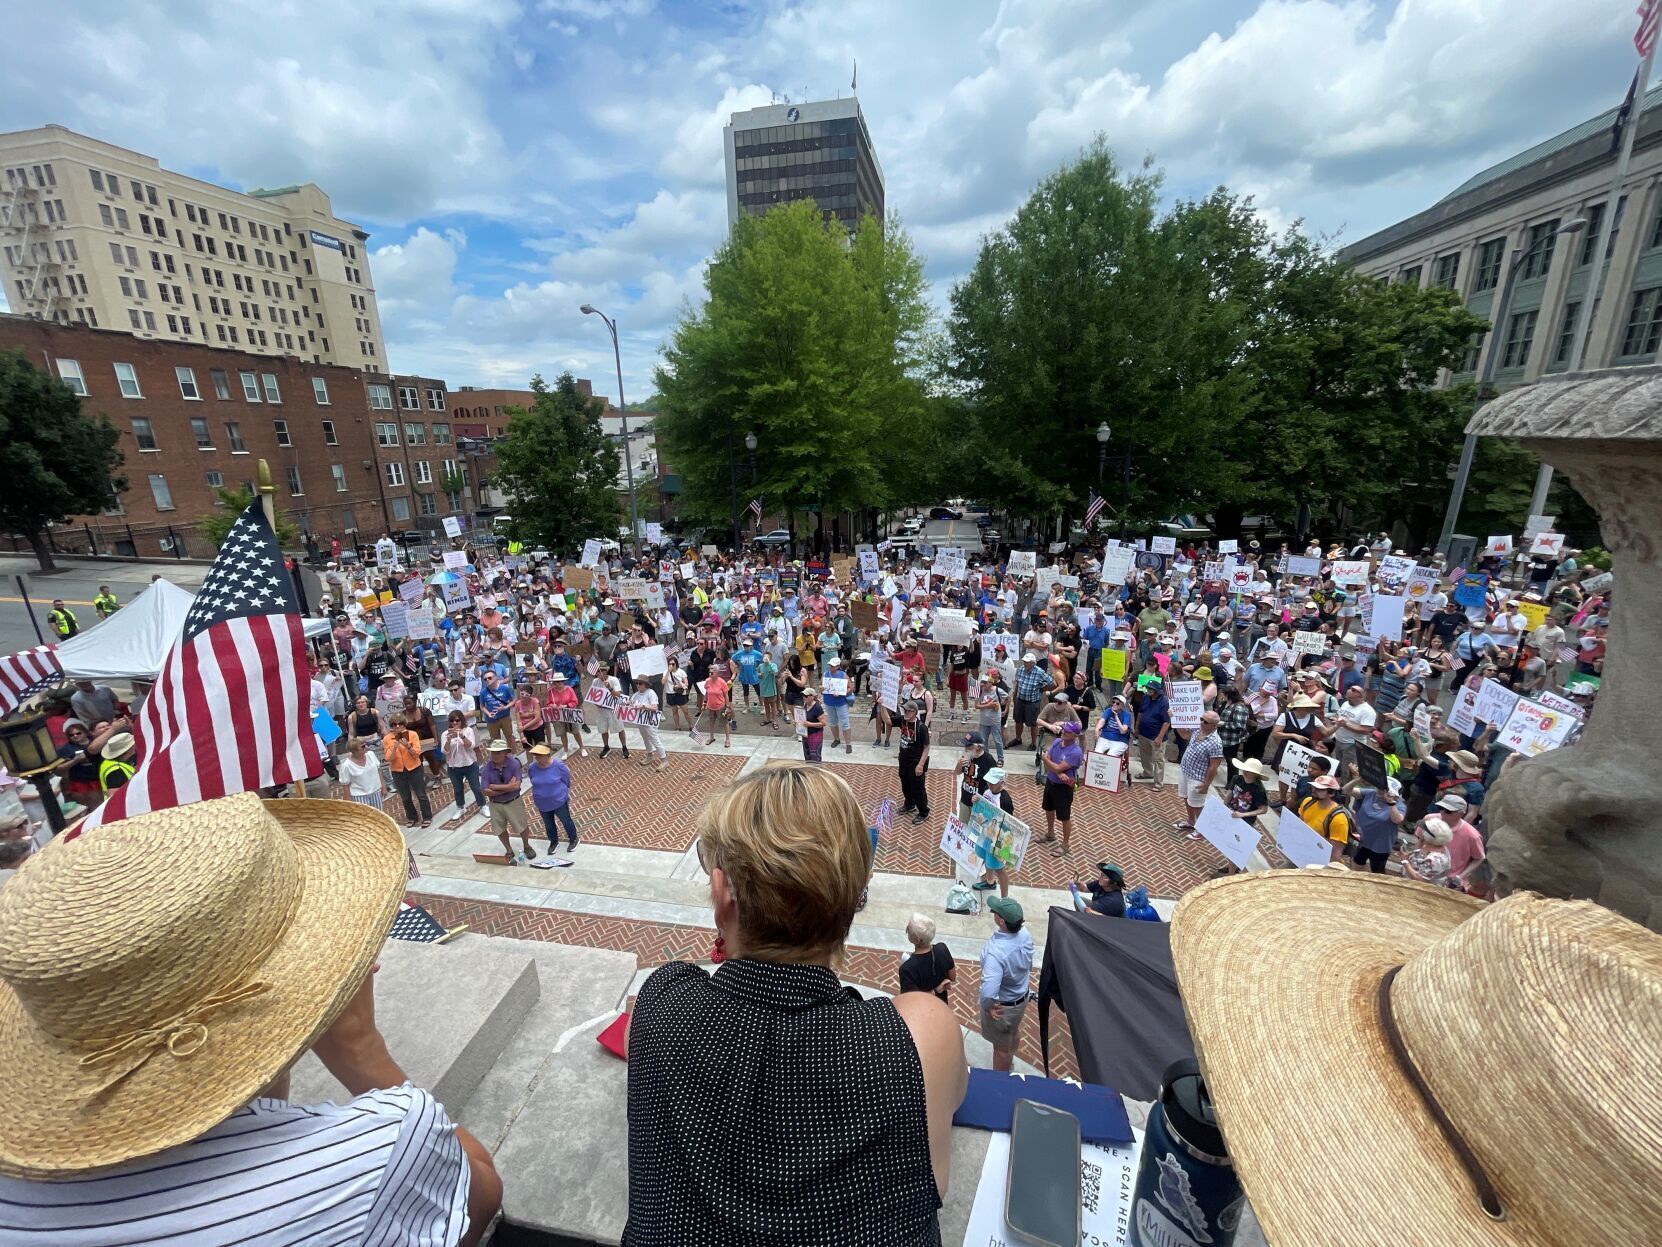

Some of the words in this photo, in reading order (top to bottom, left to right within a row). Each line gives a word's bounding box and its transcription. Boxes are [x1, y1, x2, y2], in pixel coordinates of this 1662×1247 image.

[587, 688, 603, 703] NO
[1553, 699, 1569, 711] THE
[544, 708, 560, 721] NO
[562, 708, 583, 724] KINGS
[618, 706, 637, 722] NO
[637, 709, 661, 727] KINGS
[1119, 1165, 1131, 1201] SCAN
[1115, 1206, 1128, 1247] HERE
